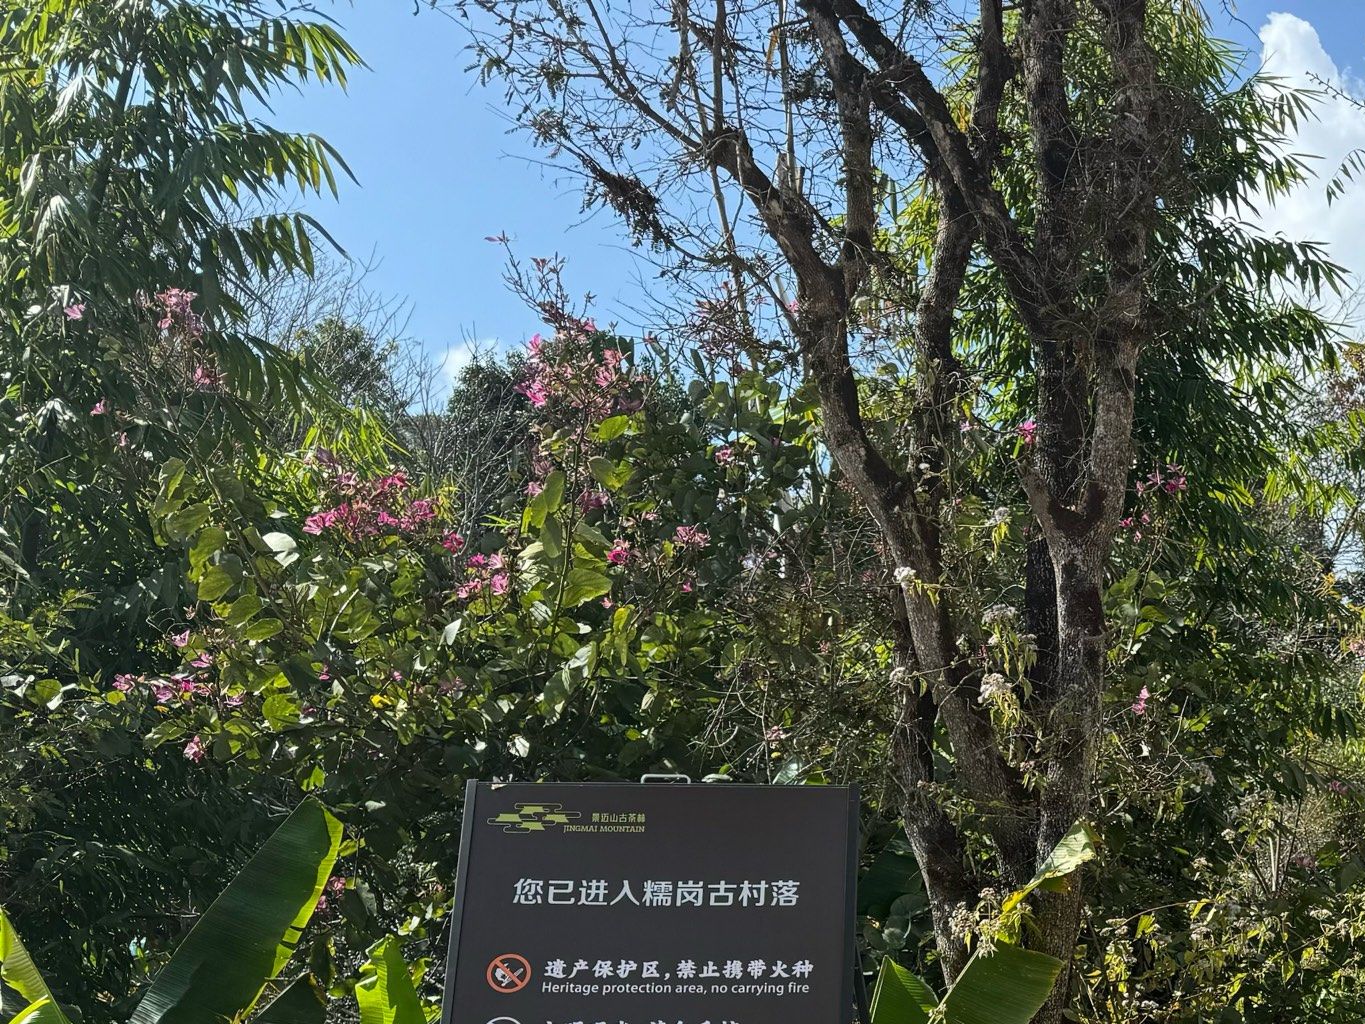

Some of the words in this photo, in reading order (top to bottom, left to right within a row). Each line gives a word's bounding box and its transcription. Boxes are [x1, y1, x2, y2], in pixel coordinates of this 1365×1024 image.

[562, 824, 598, 834] JINGMAI
[599, 825, 646, 834] MOUNTAIN
[512, 877, 801, 907] 您已进入糯岗古村落
[543, 958, 815, 981] 遗产保护区，禁止携带火种
[541, 981, 599, 996] Heritage
[602, 982, 672, 996] protection
[675, 983, 708, 996] area,
[711, 984, 728, 994] no
[731, 982, 785, 997] carrying
[787, 981, 810, 994] fire
